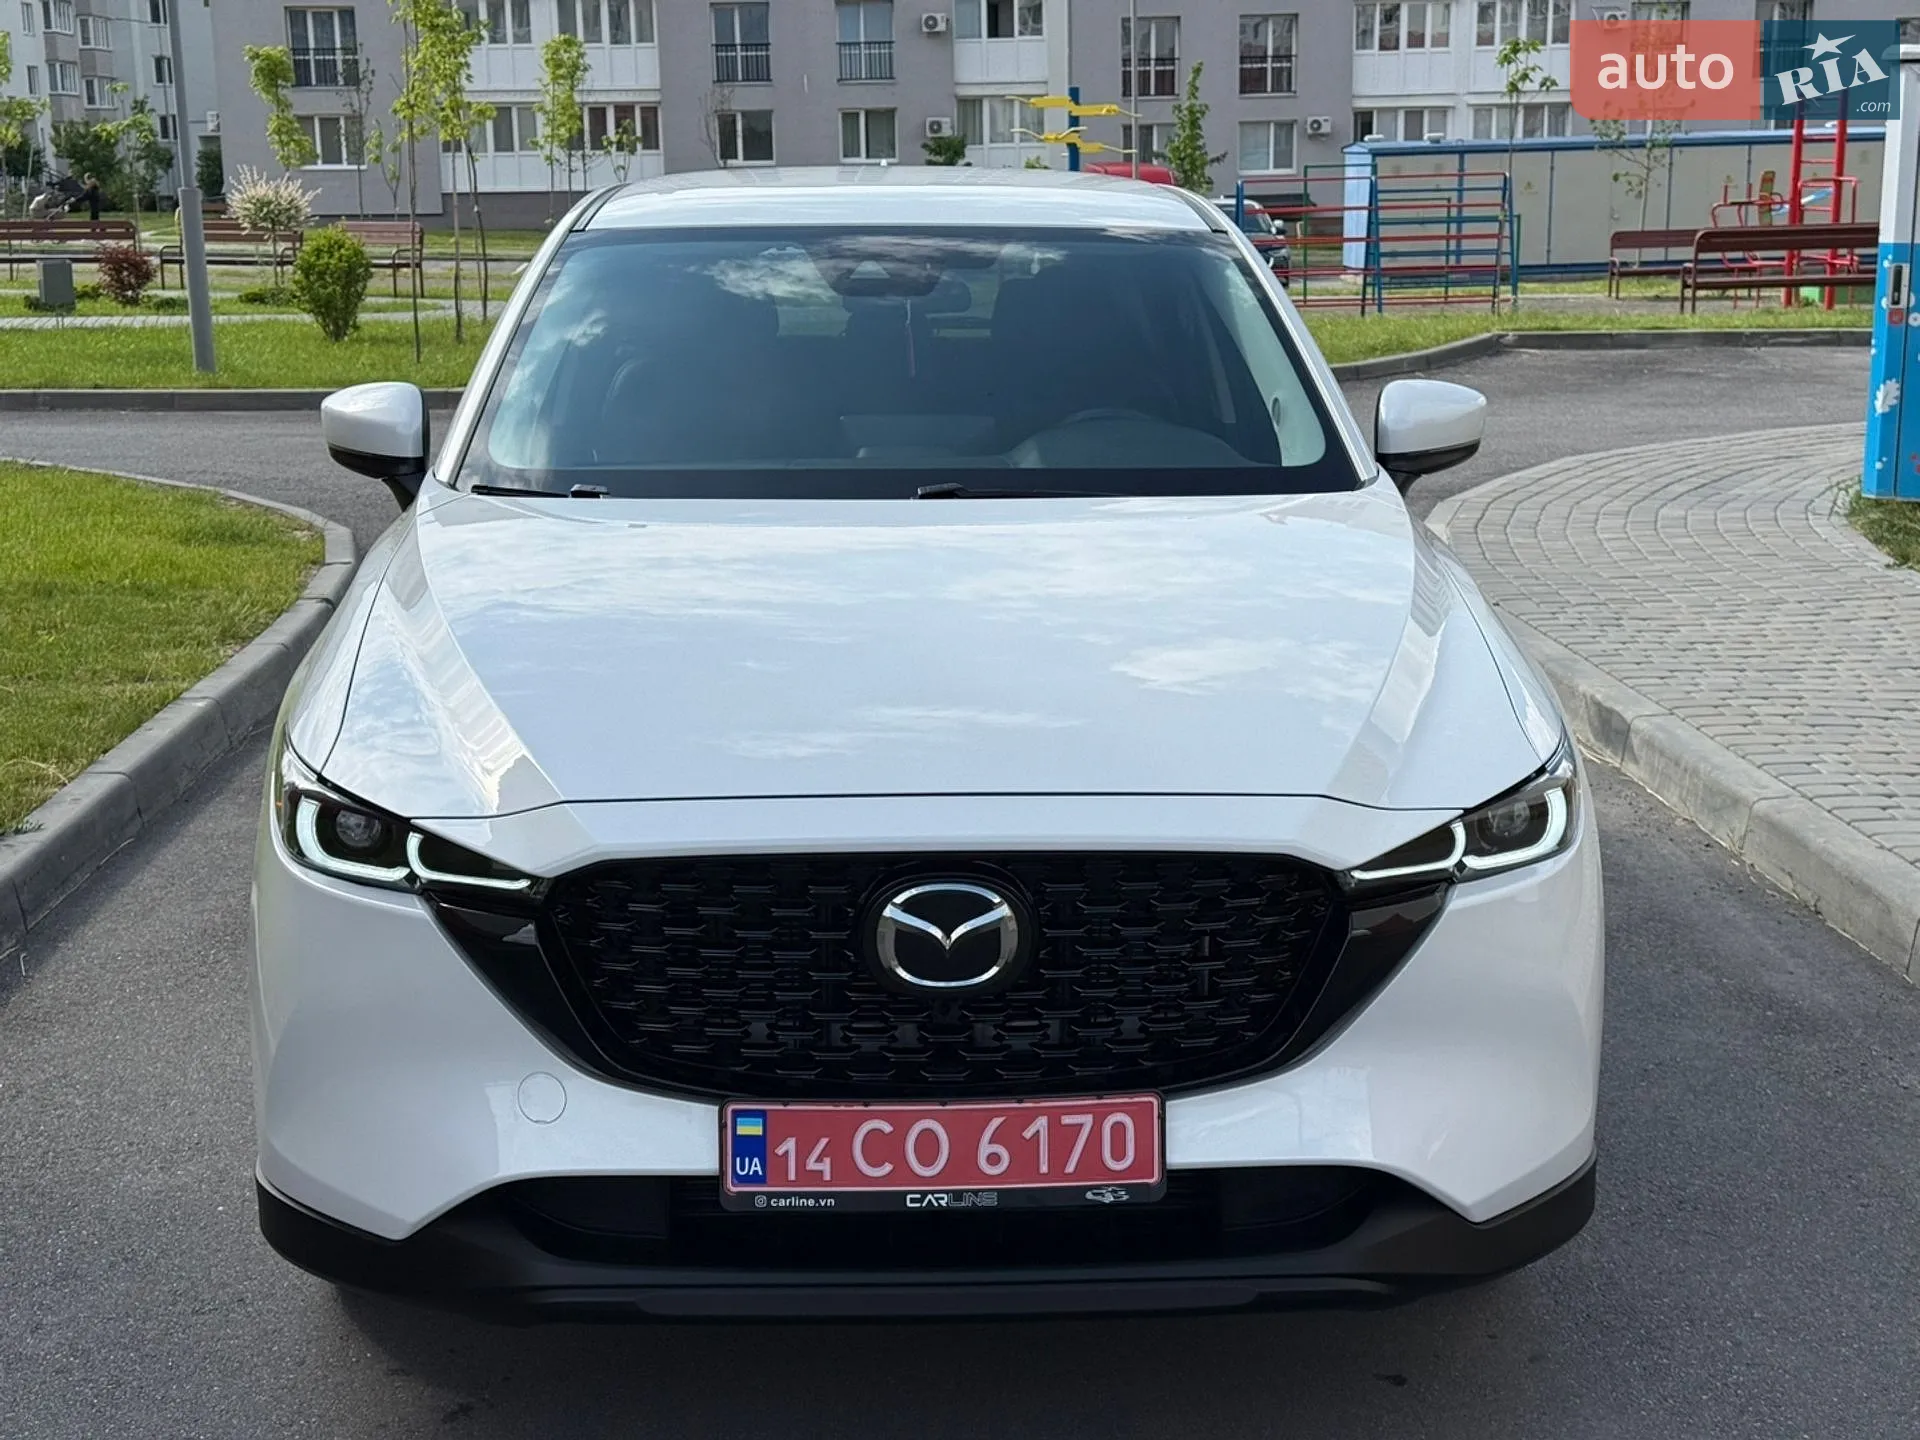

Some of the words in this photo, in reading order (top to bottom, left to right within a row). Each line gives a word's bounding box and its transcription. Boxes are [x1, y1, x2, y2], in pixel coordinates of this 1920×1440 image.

[774, 1137, 832, 1181] 14
[852, 1118, 950, 1178] CO
[977, 1112, 1135, 1175] 6170
[736, 1156, 763, 1176] UA
[771, 1196, 835, 1208] carline.vn
